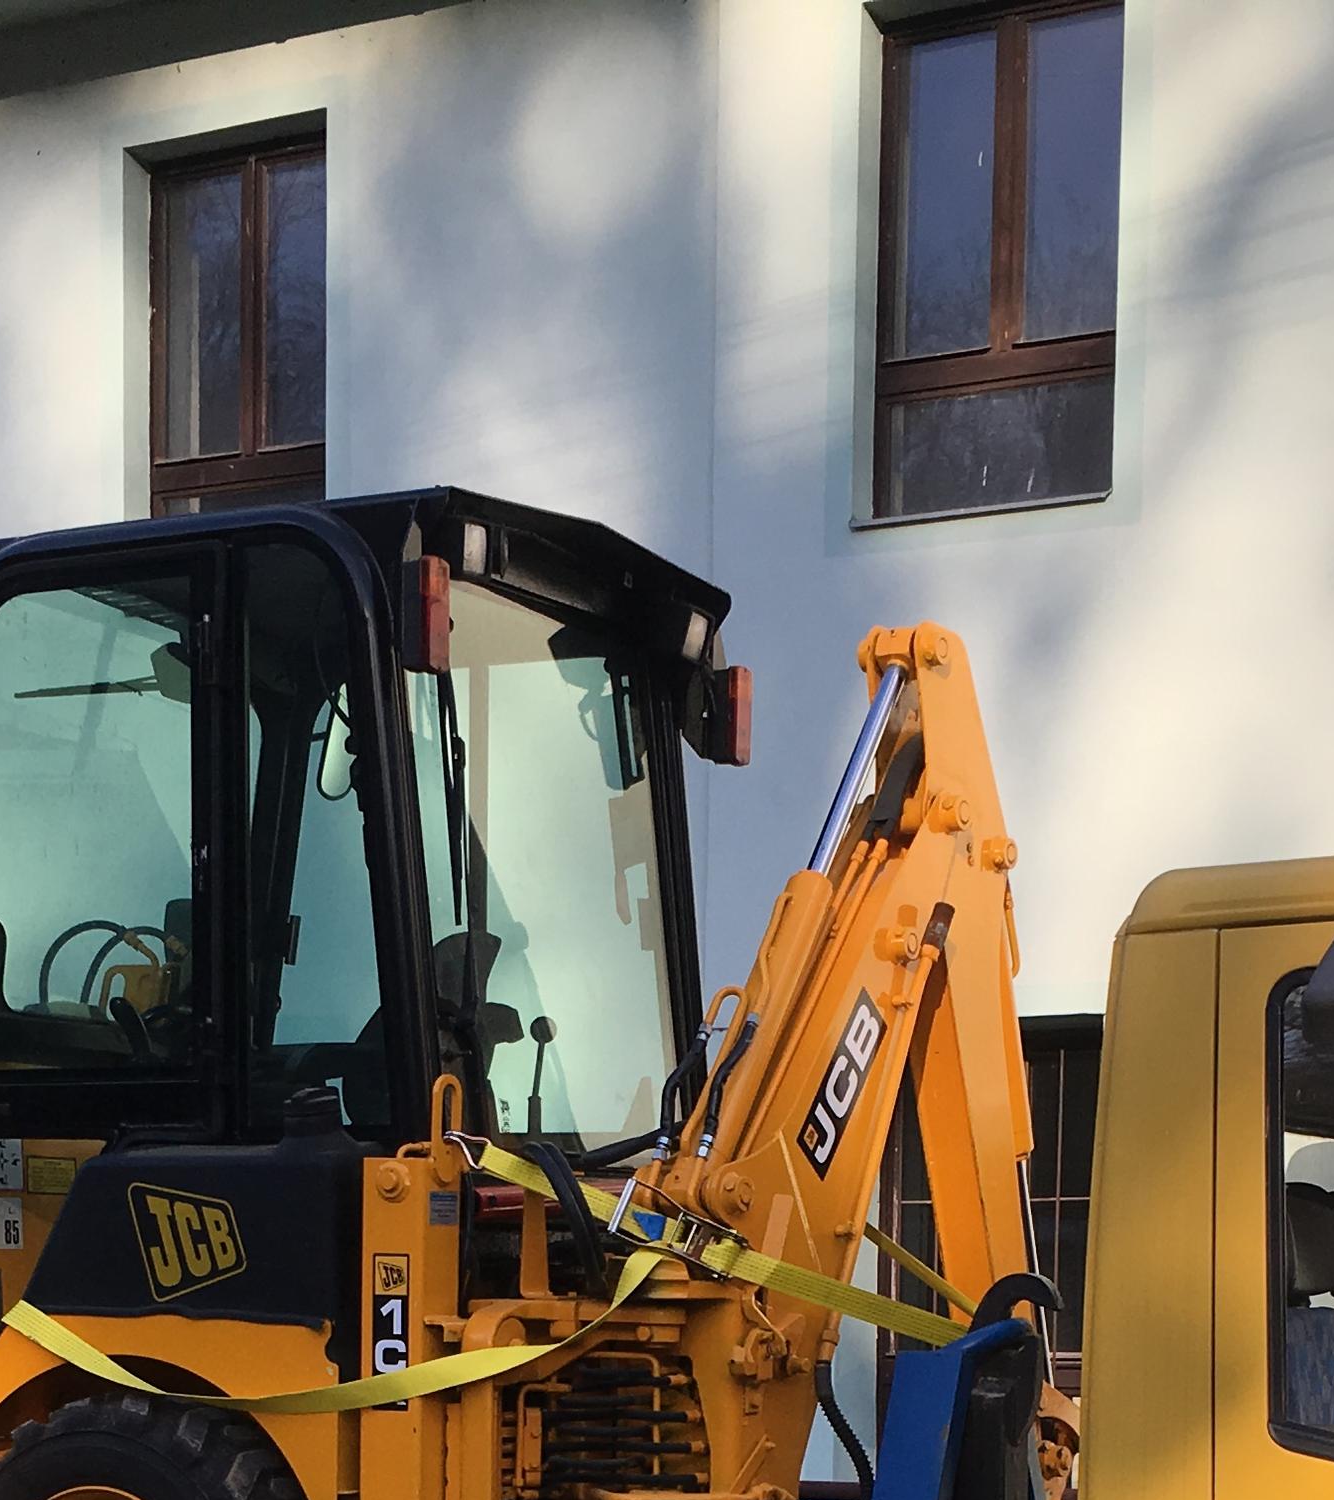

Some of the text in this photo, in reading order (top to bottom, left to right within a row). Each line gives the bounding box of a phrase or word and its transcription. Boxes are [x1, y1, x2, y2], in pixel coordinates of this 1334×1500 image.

[814, 1004, 881, 1164] JCB
[4, 1219, 20, 1245] 85
[145, 1194, 237, 1287] JCB
[381, 1264, 405, 1289] JCB
